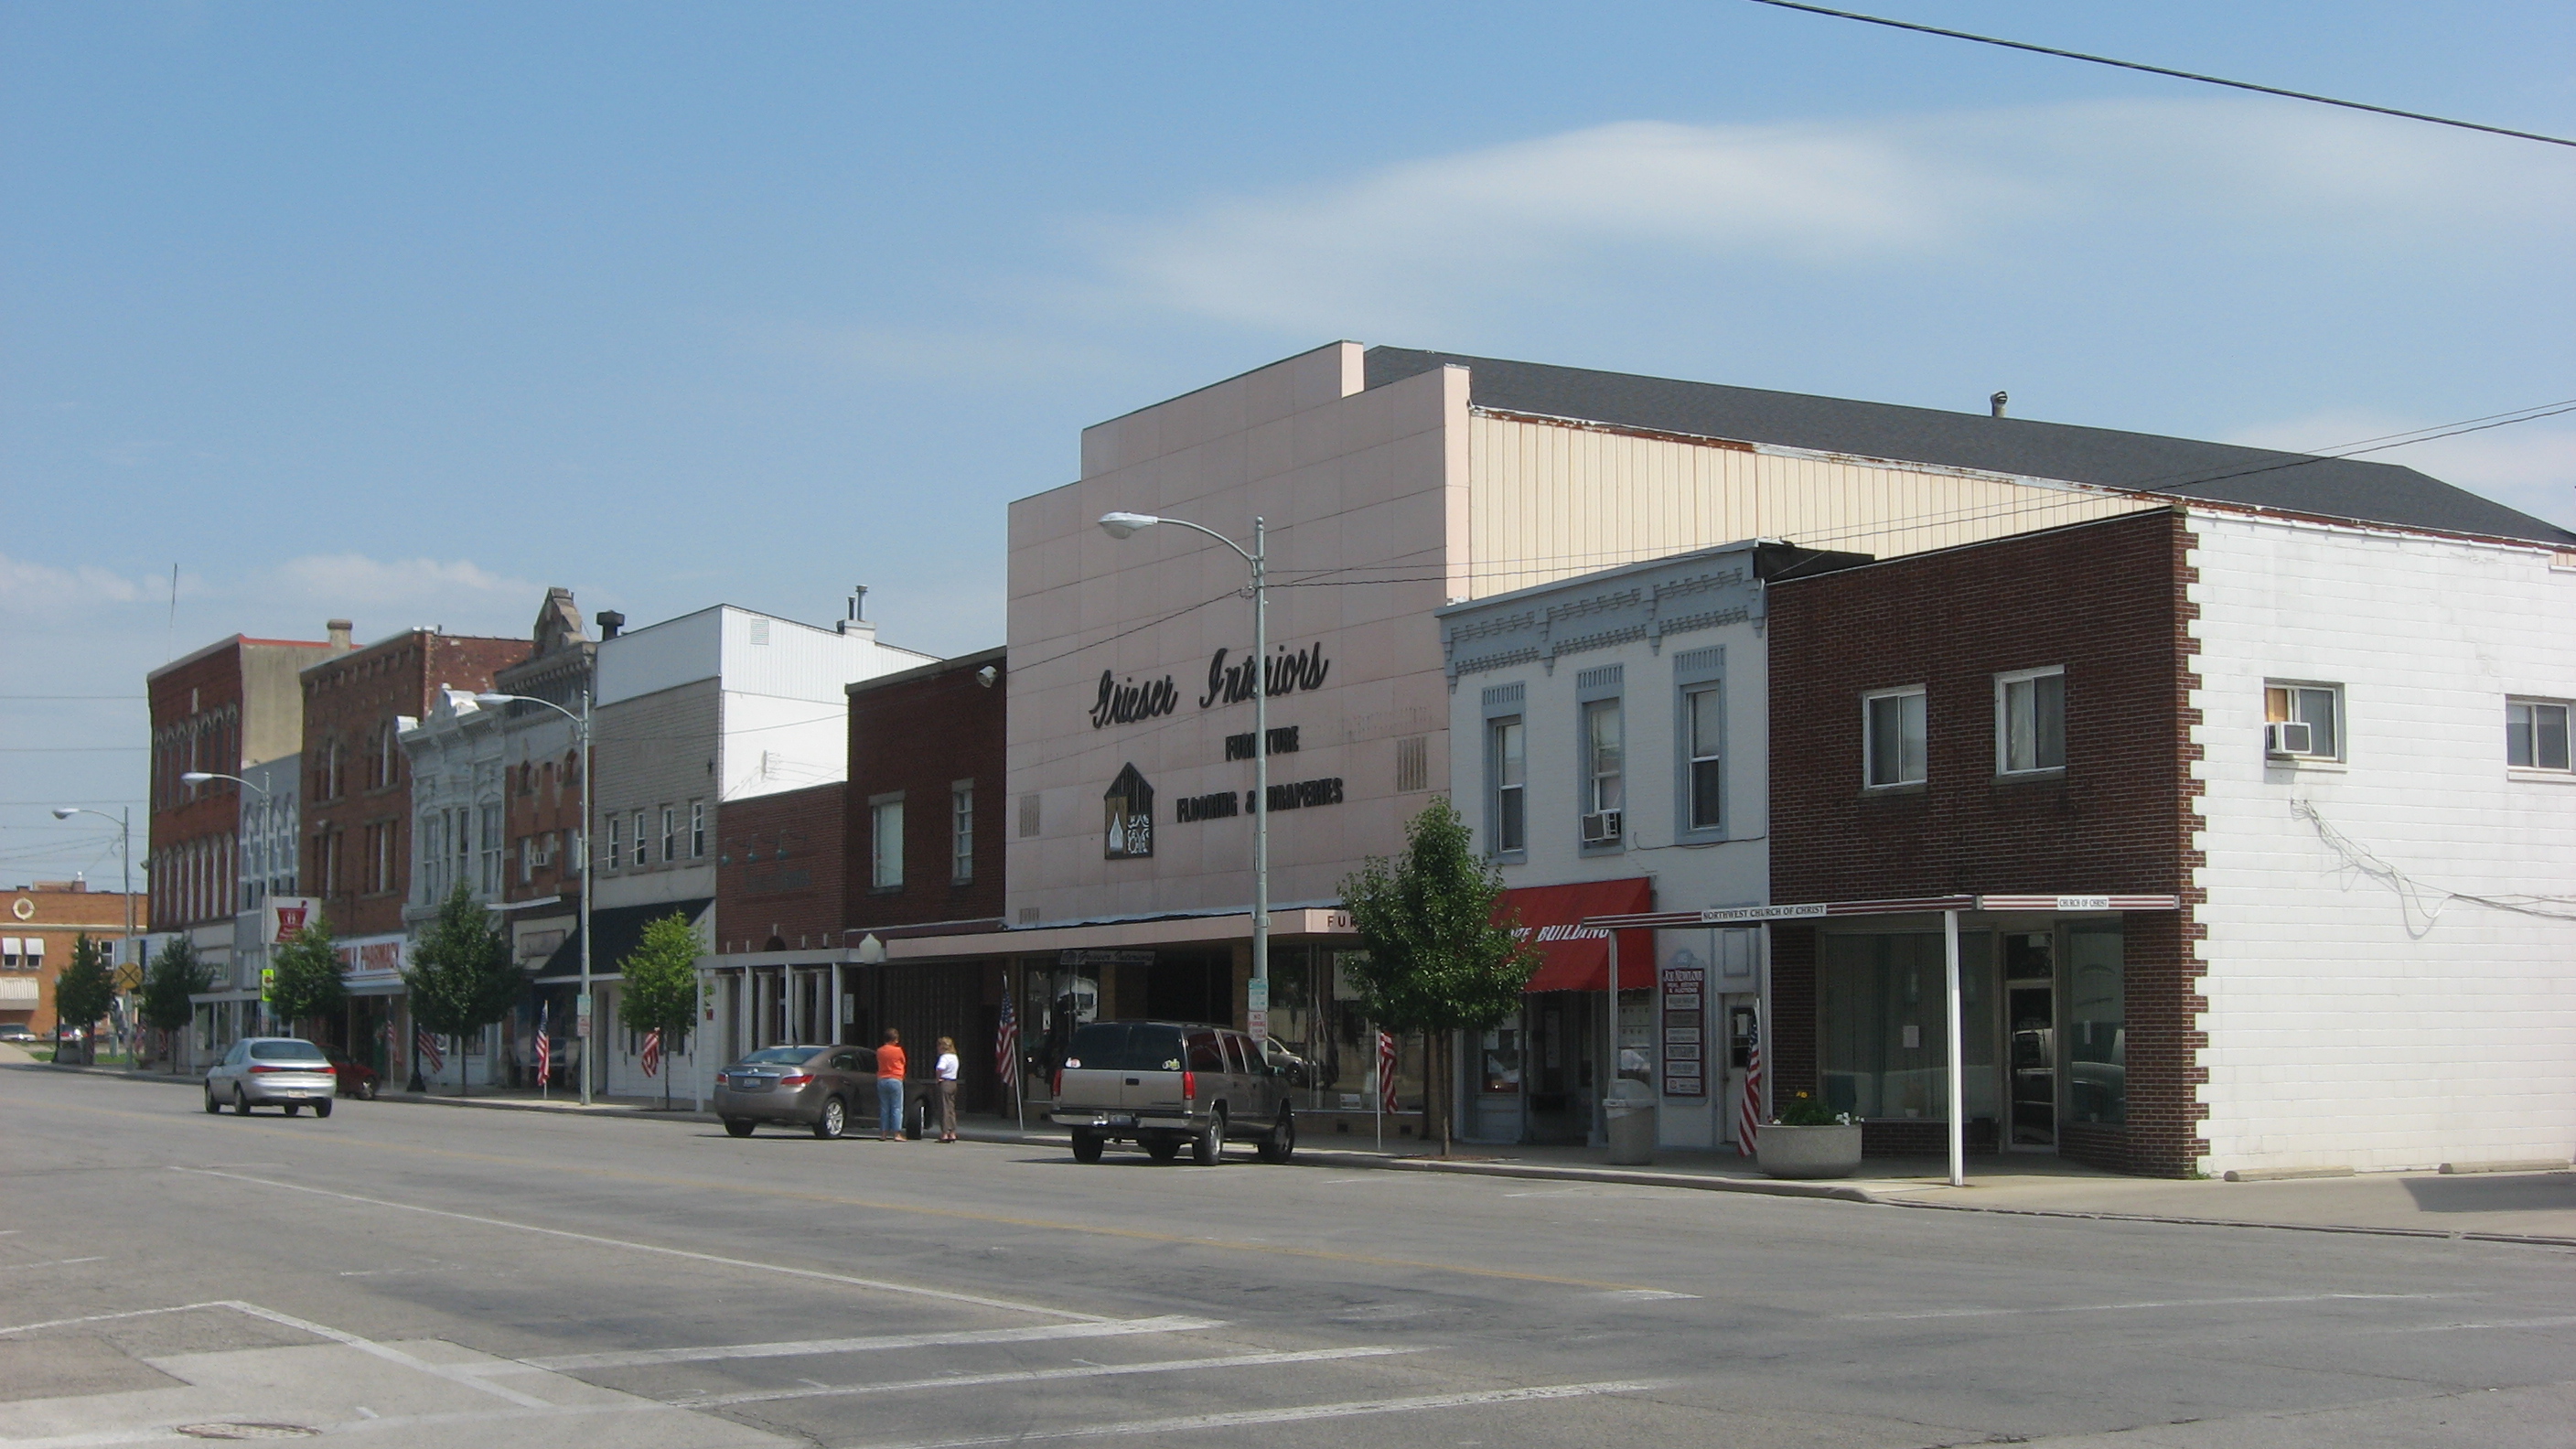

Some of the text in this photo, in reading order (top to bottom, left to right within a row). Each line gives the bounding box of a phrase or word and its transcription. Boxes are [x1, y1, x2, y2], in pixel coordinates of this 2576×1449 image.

[1089, 670, 1178, 729] Grieser
[1225, 725, 1299, 762] FURTURE
[1176, 791, 1238, 823] FLOORING
[1266, 778, 1343, 812] DRAPERIES
[1702, 905, 1824, 920] NORTHWEST CHURCH OF CHRIST
[2059, 898, 2080, 907] CHURCH
[1327, 916, 1357, 928] FUR
